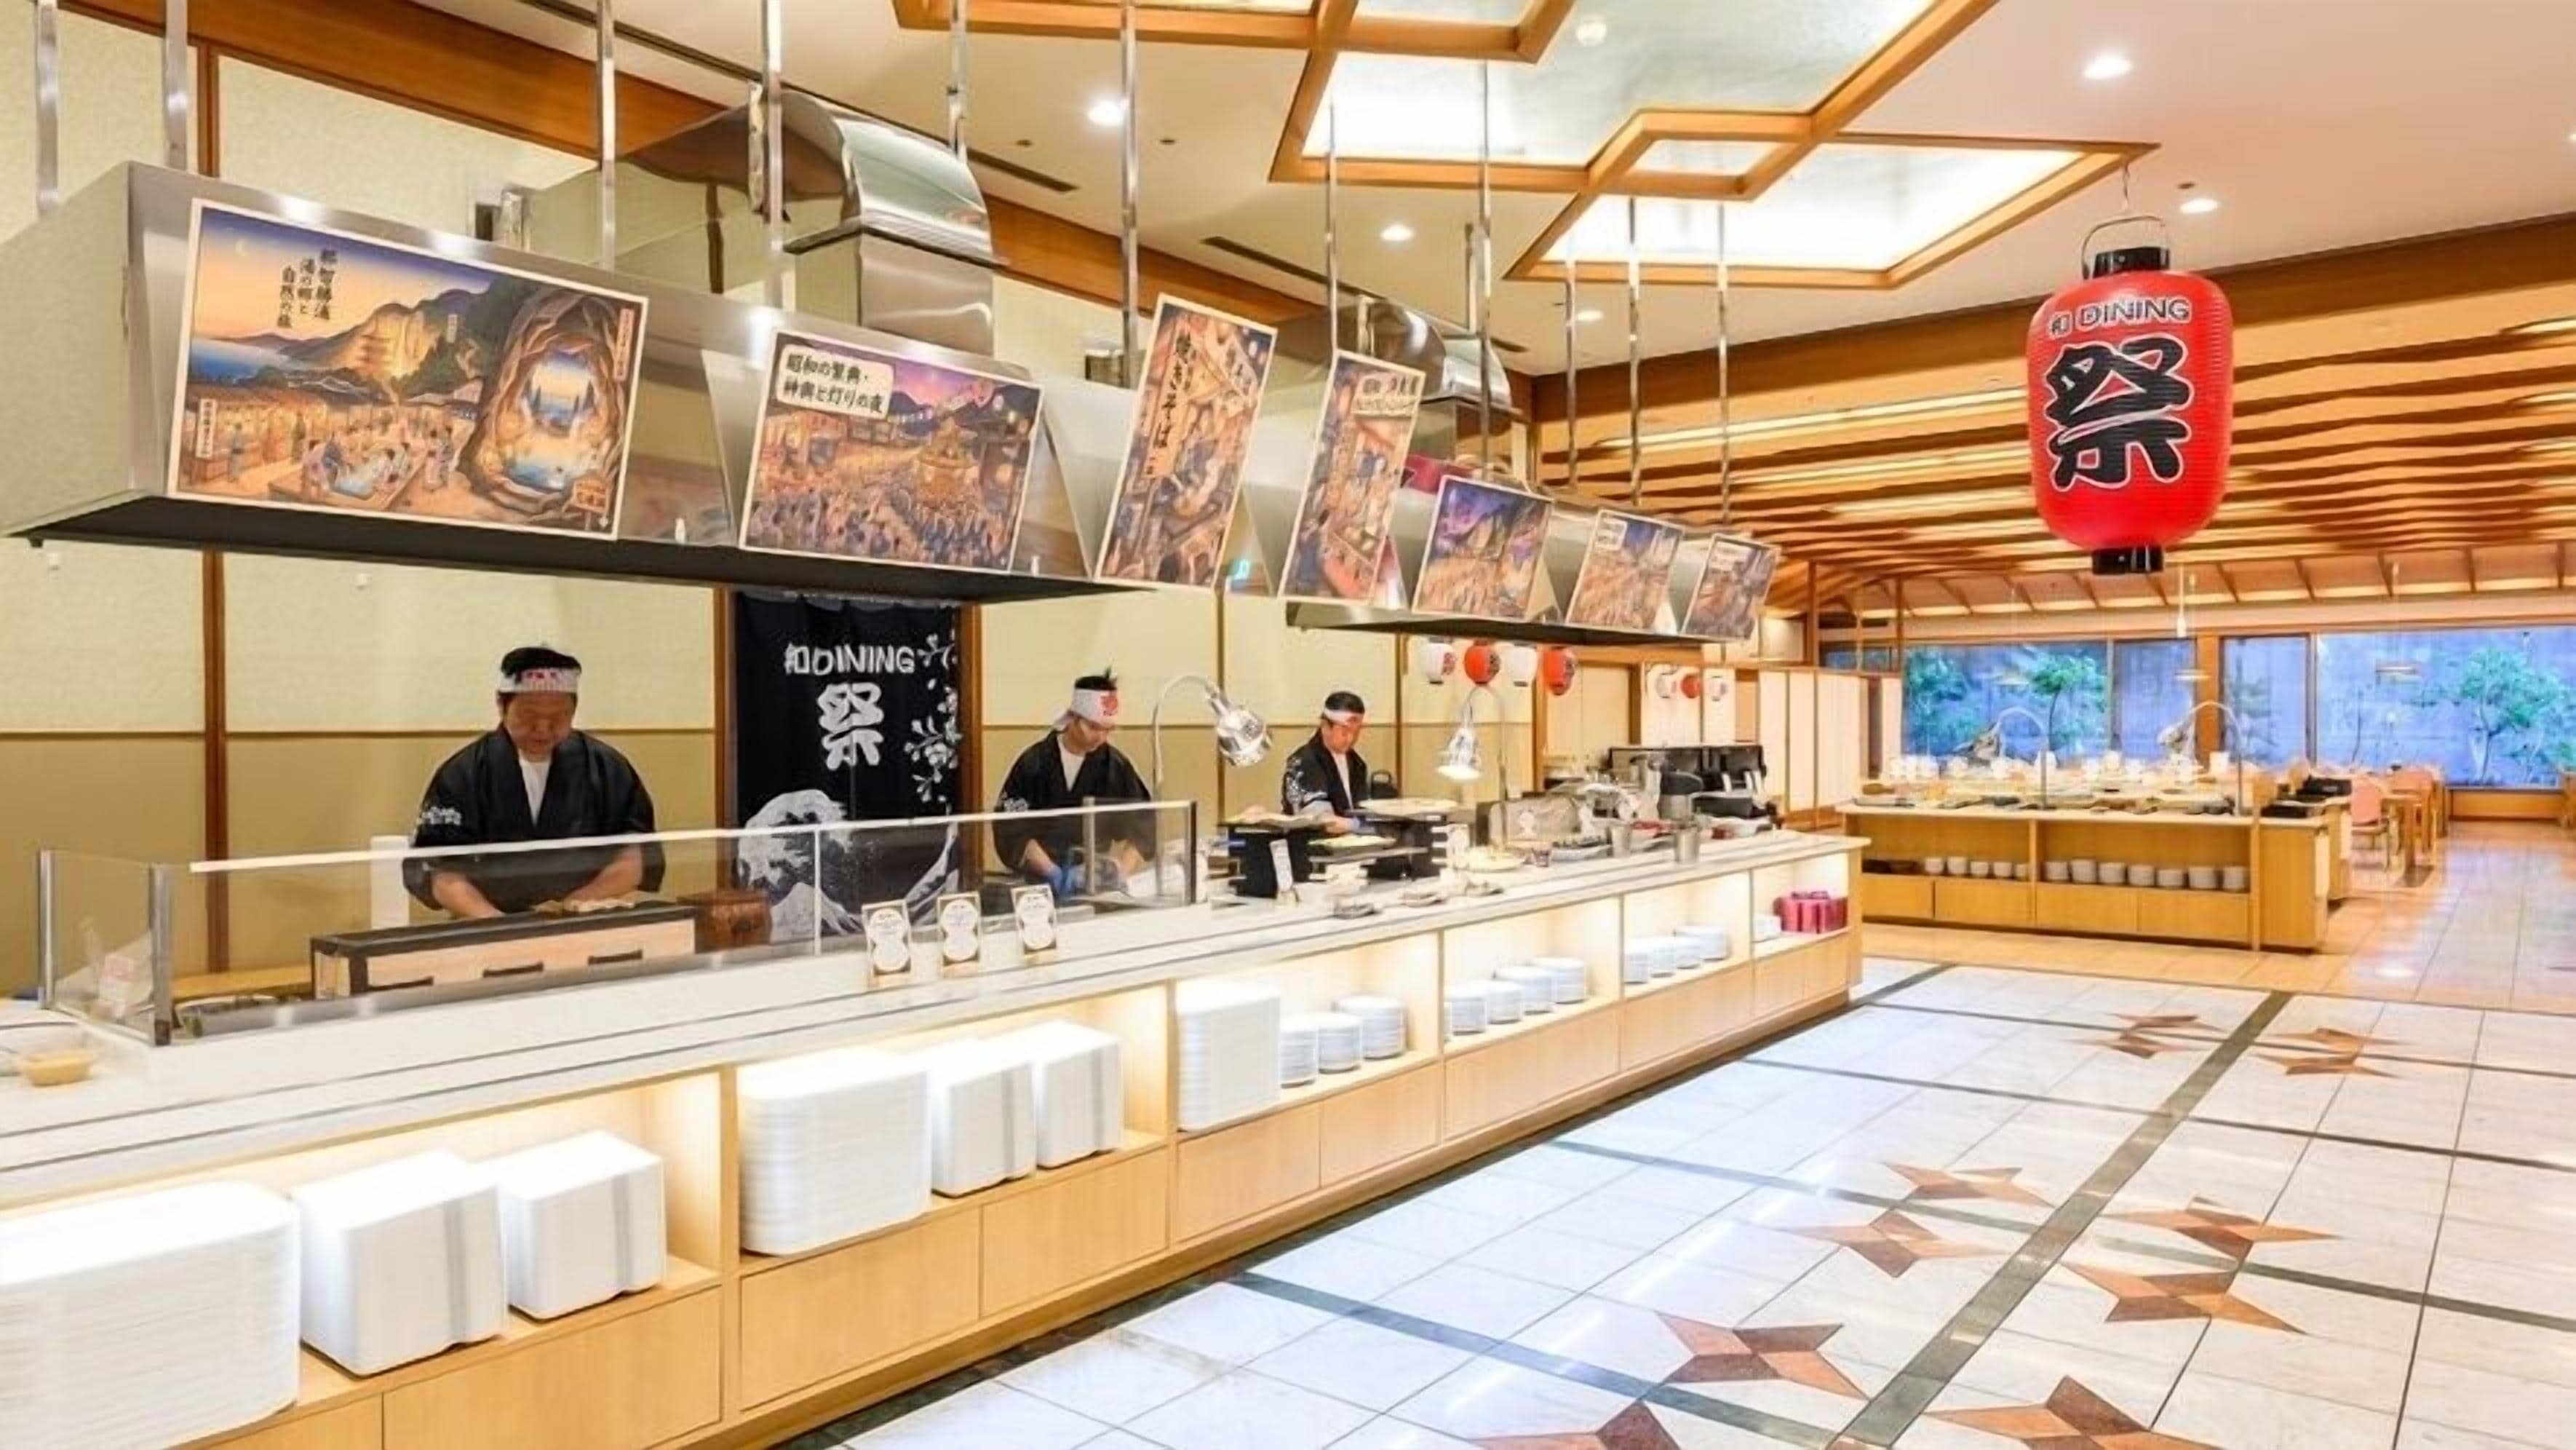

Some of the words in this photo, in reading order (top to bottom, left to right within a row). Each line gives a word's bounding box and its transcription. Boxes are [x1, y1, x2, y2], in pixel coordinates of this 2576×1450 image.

[2048, 313, 2072, 336] 和
[2080, 298, 2191, 328] DINING
[2046, 333, 2193, 491] 祭
[817, 681, 884, 771] 祭
